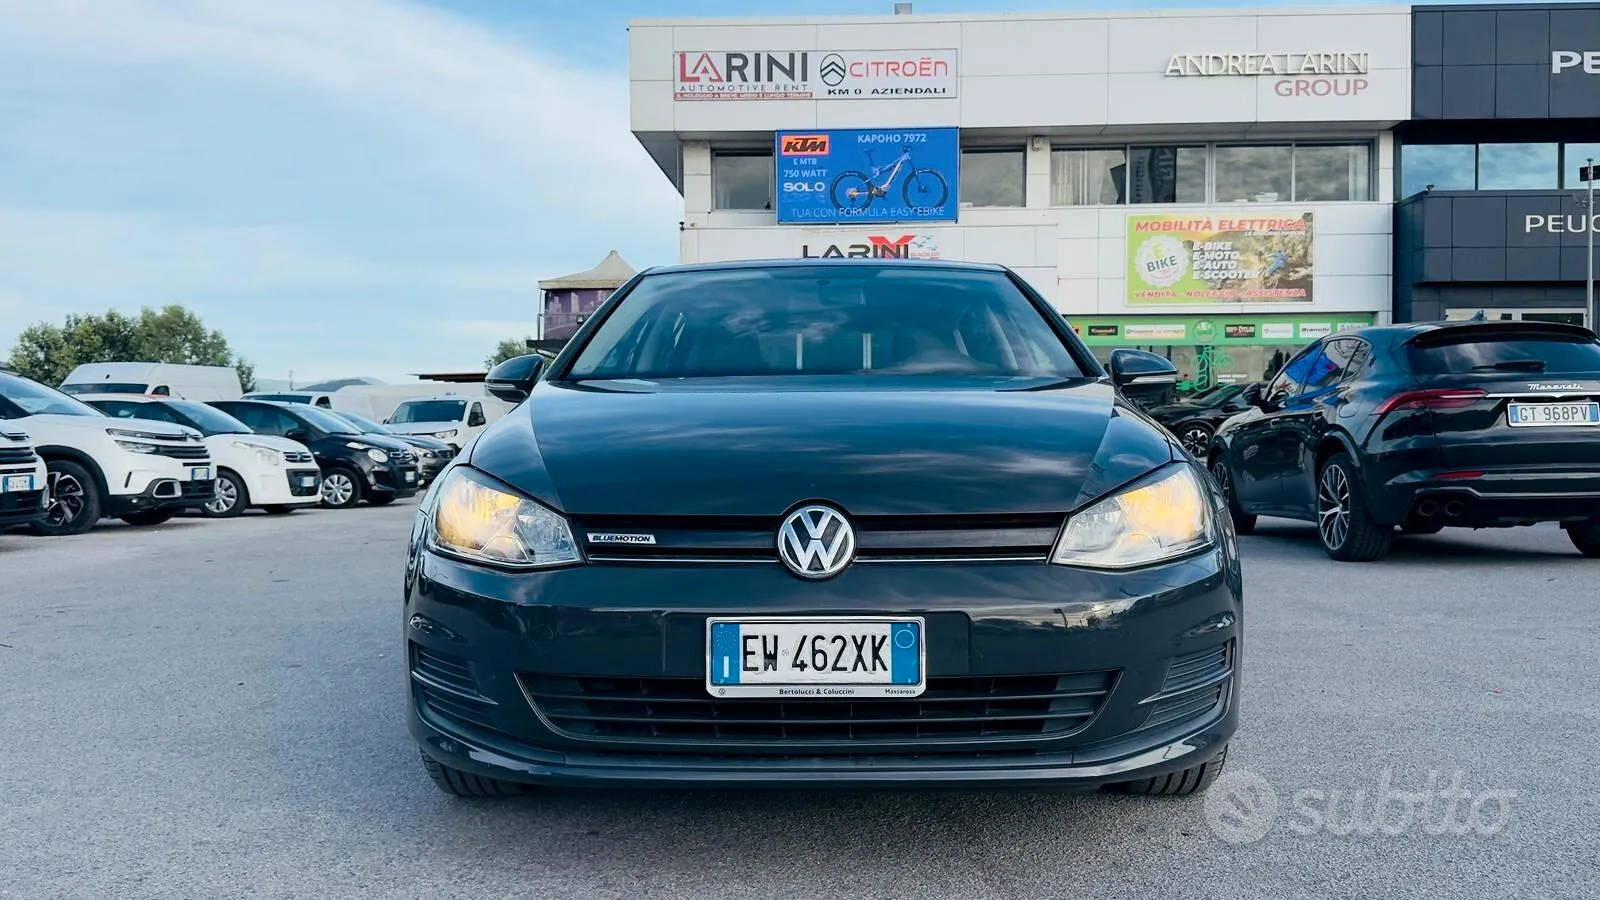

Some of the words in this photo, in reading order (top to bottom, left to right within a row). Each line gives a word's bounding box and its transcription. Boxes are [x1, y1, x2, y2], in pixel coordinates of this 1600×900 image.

[679, 52, 808, 82] LARINI
[1165, 53, 1276, 76] ANDREA
[1286, 52, 1368, 75] LARINI
[680, 84, 768, 92] AUTOMOTIVE
[871, 87, 946, 95] AZIENDALI
[1274, 79, 1369, 97] GROUP
[857, 133, 901, 144] KAPOHO
[903, 133, 927, 143] 7972
[783, 137, 827, 153] KTM
[800, 158, 817, 166] MTB
[783, 169, 799, 178] 750
[801, 169, 827, 178] WATT
[783, 182, 826, 192] SOLO
[791, 208, 811, 218] TUA
[813, 208, 836, 218] CON
[838, 207, 888, 218] FORMULA
[890, 207, 914, 217] EASY
[916, 206, 945, 217] EBIKE
[1135, 217, 1214, 232] MOBILITÀ
[1218, 218, 1307, 232] ELETTRICA
[802, 244, 909, 259] LARINI
[1192, 241, 1233, 251] E-BIKE
[1192, 250, 1240, 260] E-MOTO
[1146, 255, 1178, 273] BIKE
[1192, 260, 1238, 270] E-AUTO
[1519, 407, 1537, 421] GT
[1543, 406, 1588, 421] 968PV
[592, 534, 651, 543] BLUEMOTION
[742, 635, 779, 671] EW
[791, 635, 888, 671] 462XK
